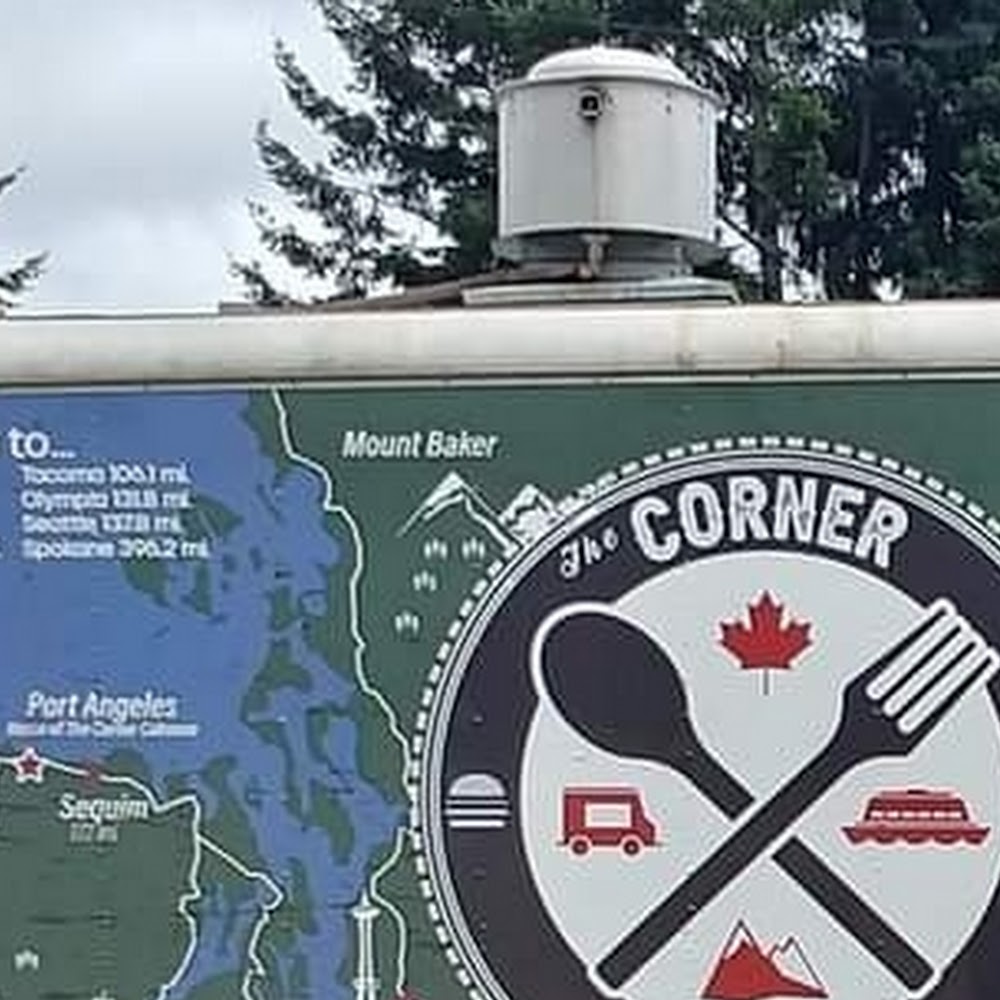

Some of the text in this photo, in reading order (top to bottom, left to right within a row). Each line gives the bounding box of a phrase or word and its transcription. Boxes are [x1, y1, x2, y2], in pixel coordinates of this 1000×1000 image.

[9, 426, 76, 459] to...
[342, 430, 499, 458] Mount Baker
[560, 475, 908, 579] The CORNER
[26, 690, 178, 722] Port Angeles
[59, 793, 149, 824] Sequim
